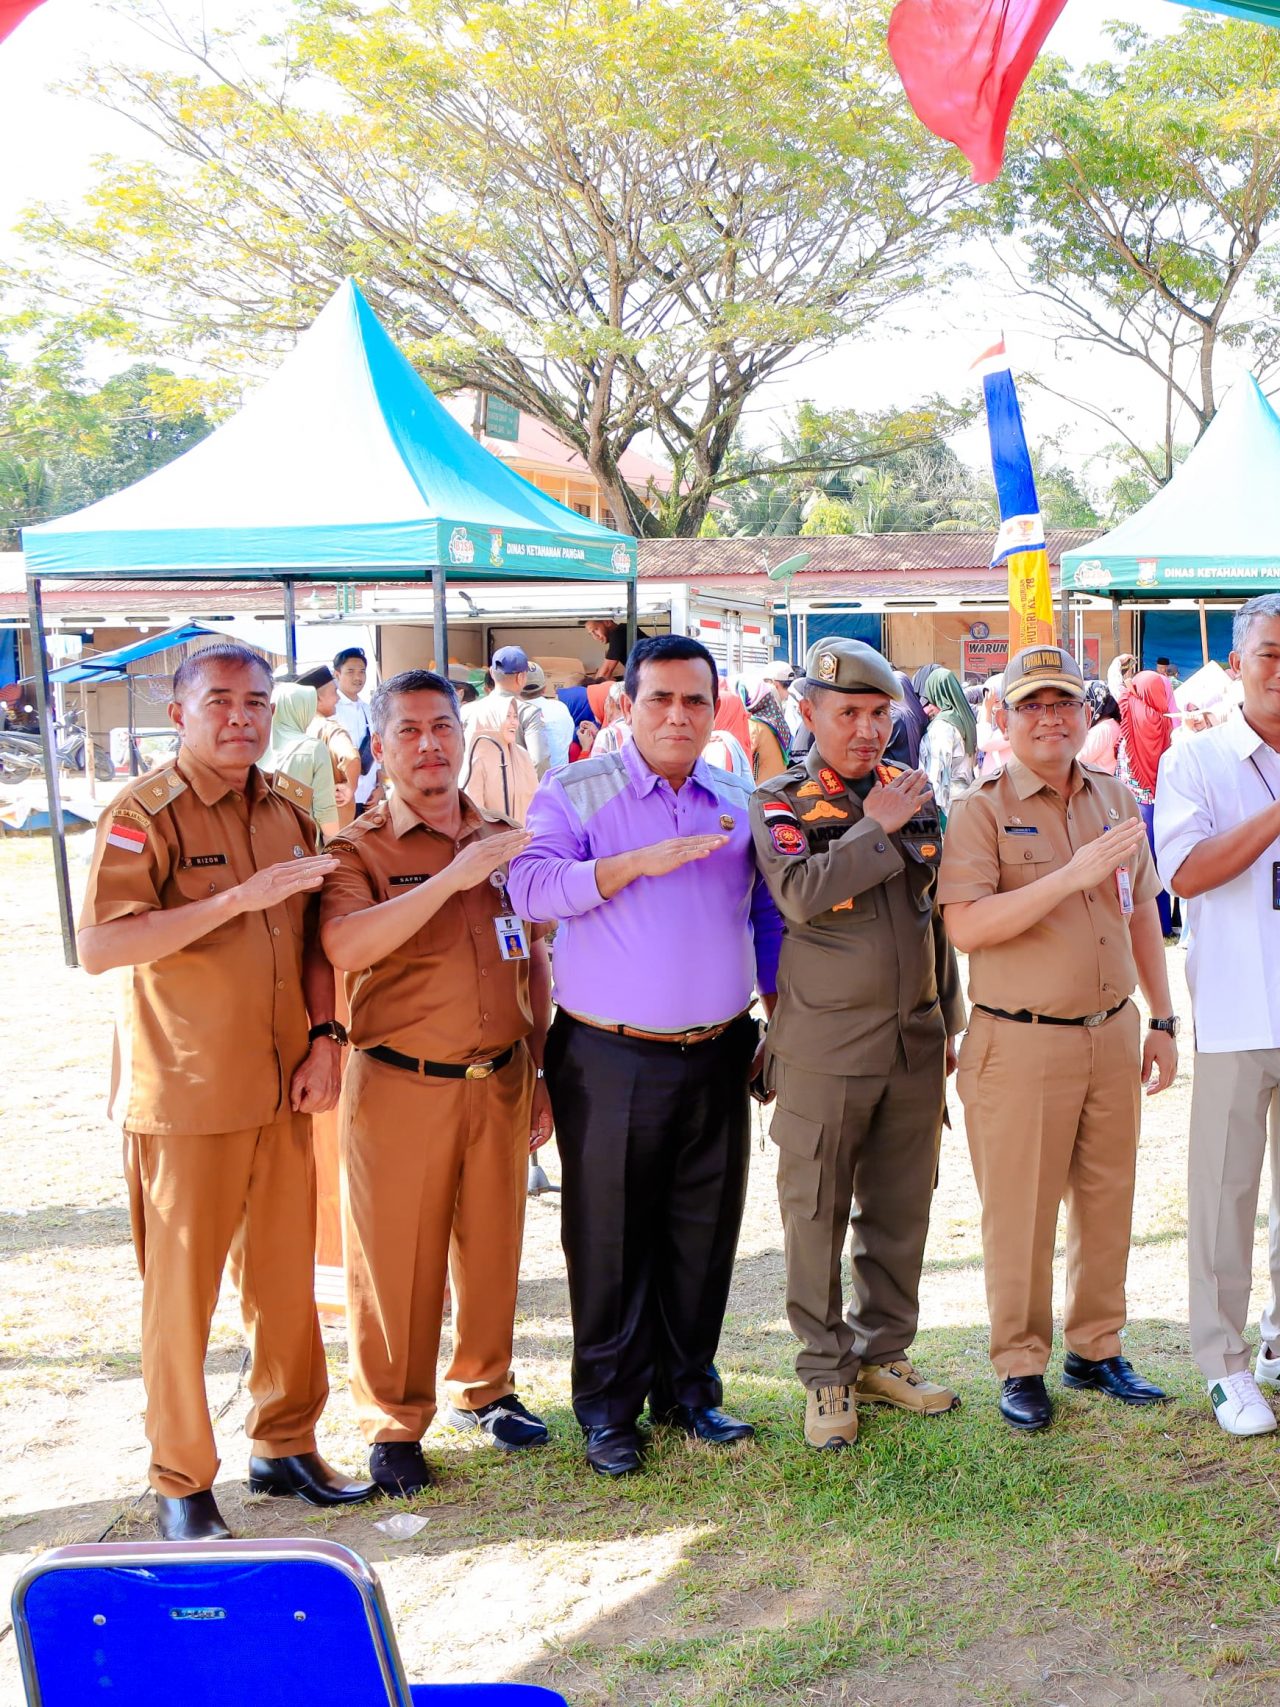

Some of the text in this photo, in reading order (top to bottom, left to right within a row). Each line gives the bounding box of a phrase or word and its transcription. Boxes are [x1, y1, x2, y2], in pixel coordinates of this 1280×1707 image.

[506, 543, 585, 560] DINAS KETAHANAN PANGAN
[1164, 567, 1194, 578] DINAS
[1197, 567, 1258, 578] KETAHANAN
[1026, 625, 1037, 644] HUT
[969, 643, 1008, 654] WARUN
